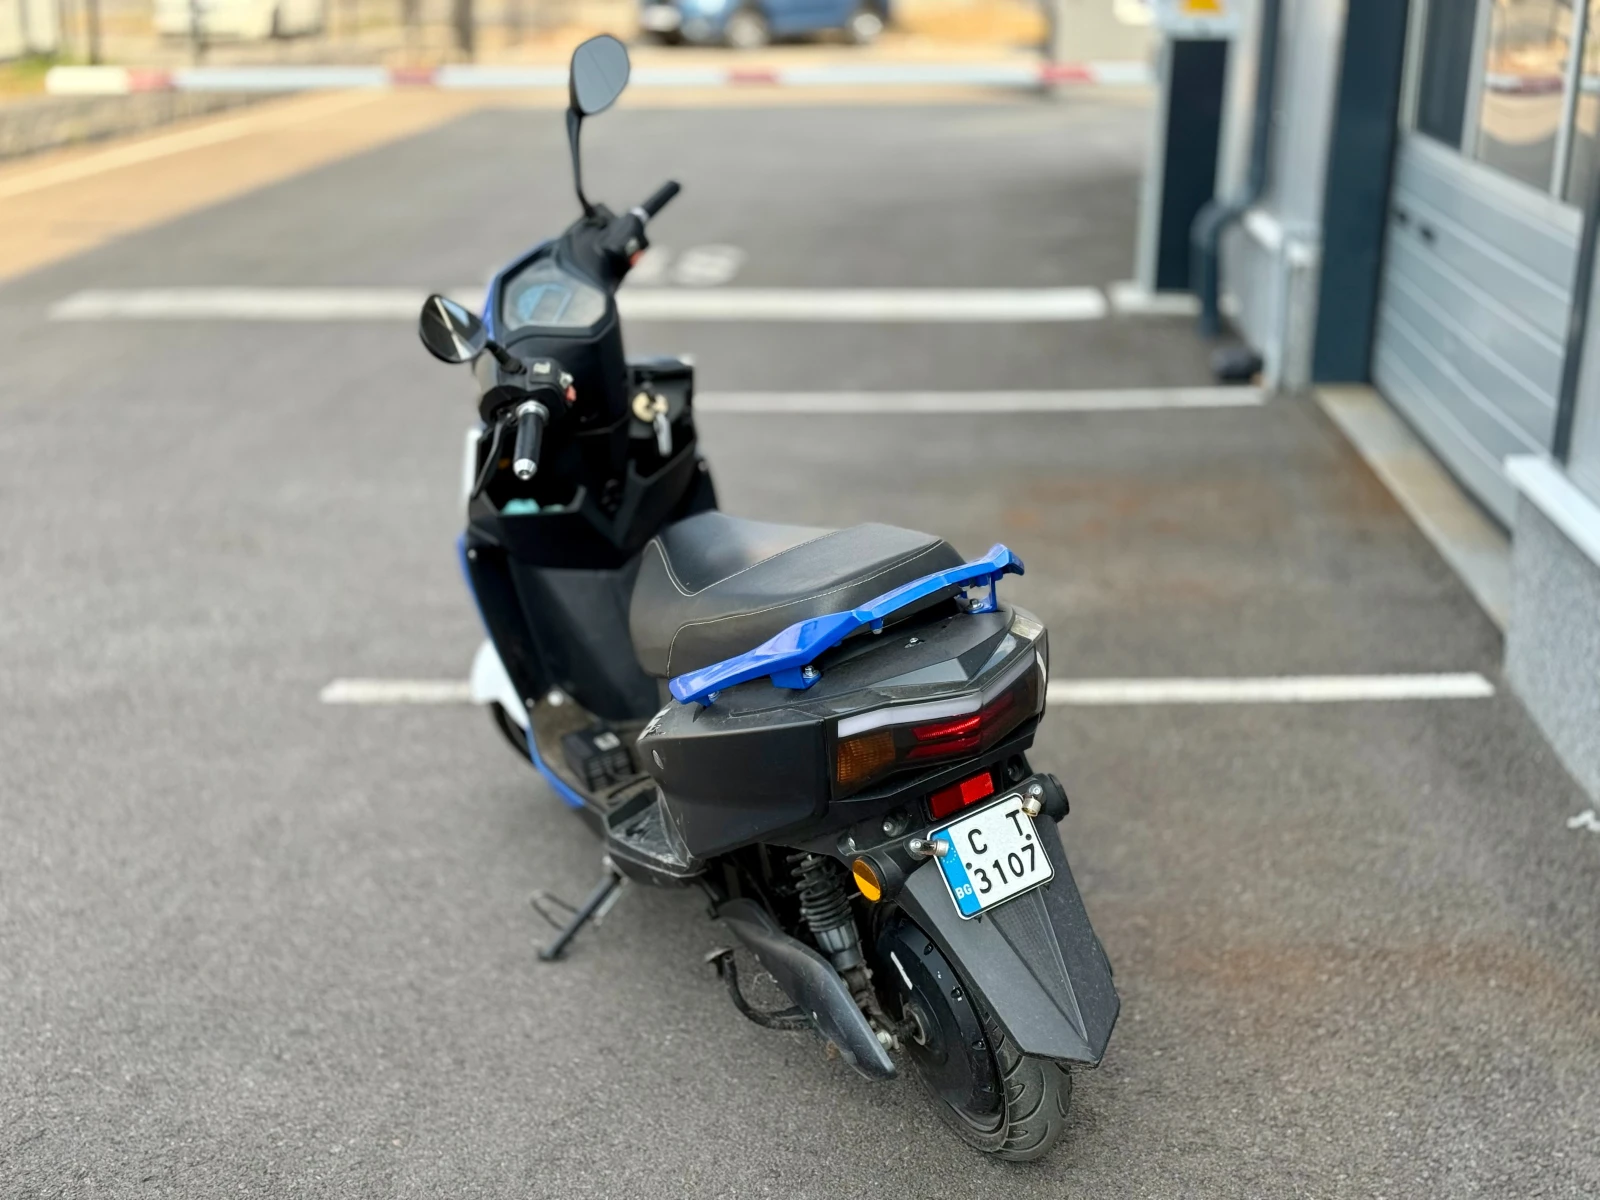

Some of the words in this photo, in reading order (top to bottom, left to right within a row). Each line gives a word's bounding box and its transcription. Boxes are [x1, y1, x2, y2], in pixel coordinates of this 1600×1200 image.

[967, 828, 988, 855] C
[1005, 809, 1023, 837] T
[954, 883, 973, 900] BG
[974, 843, 1036, 894] 3107
